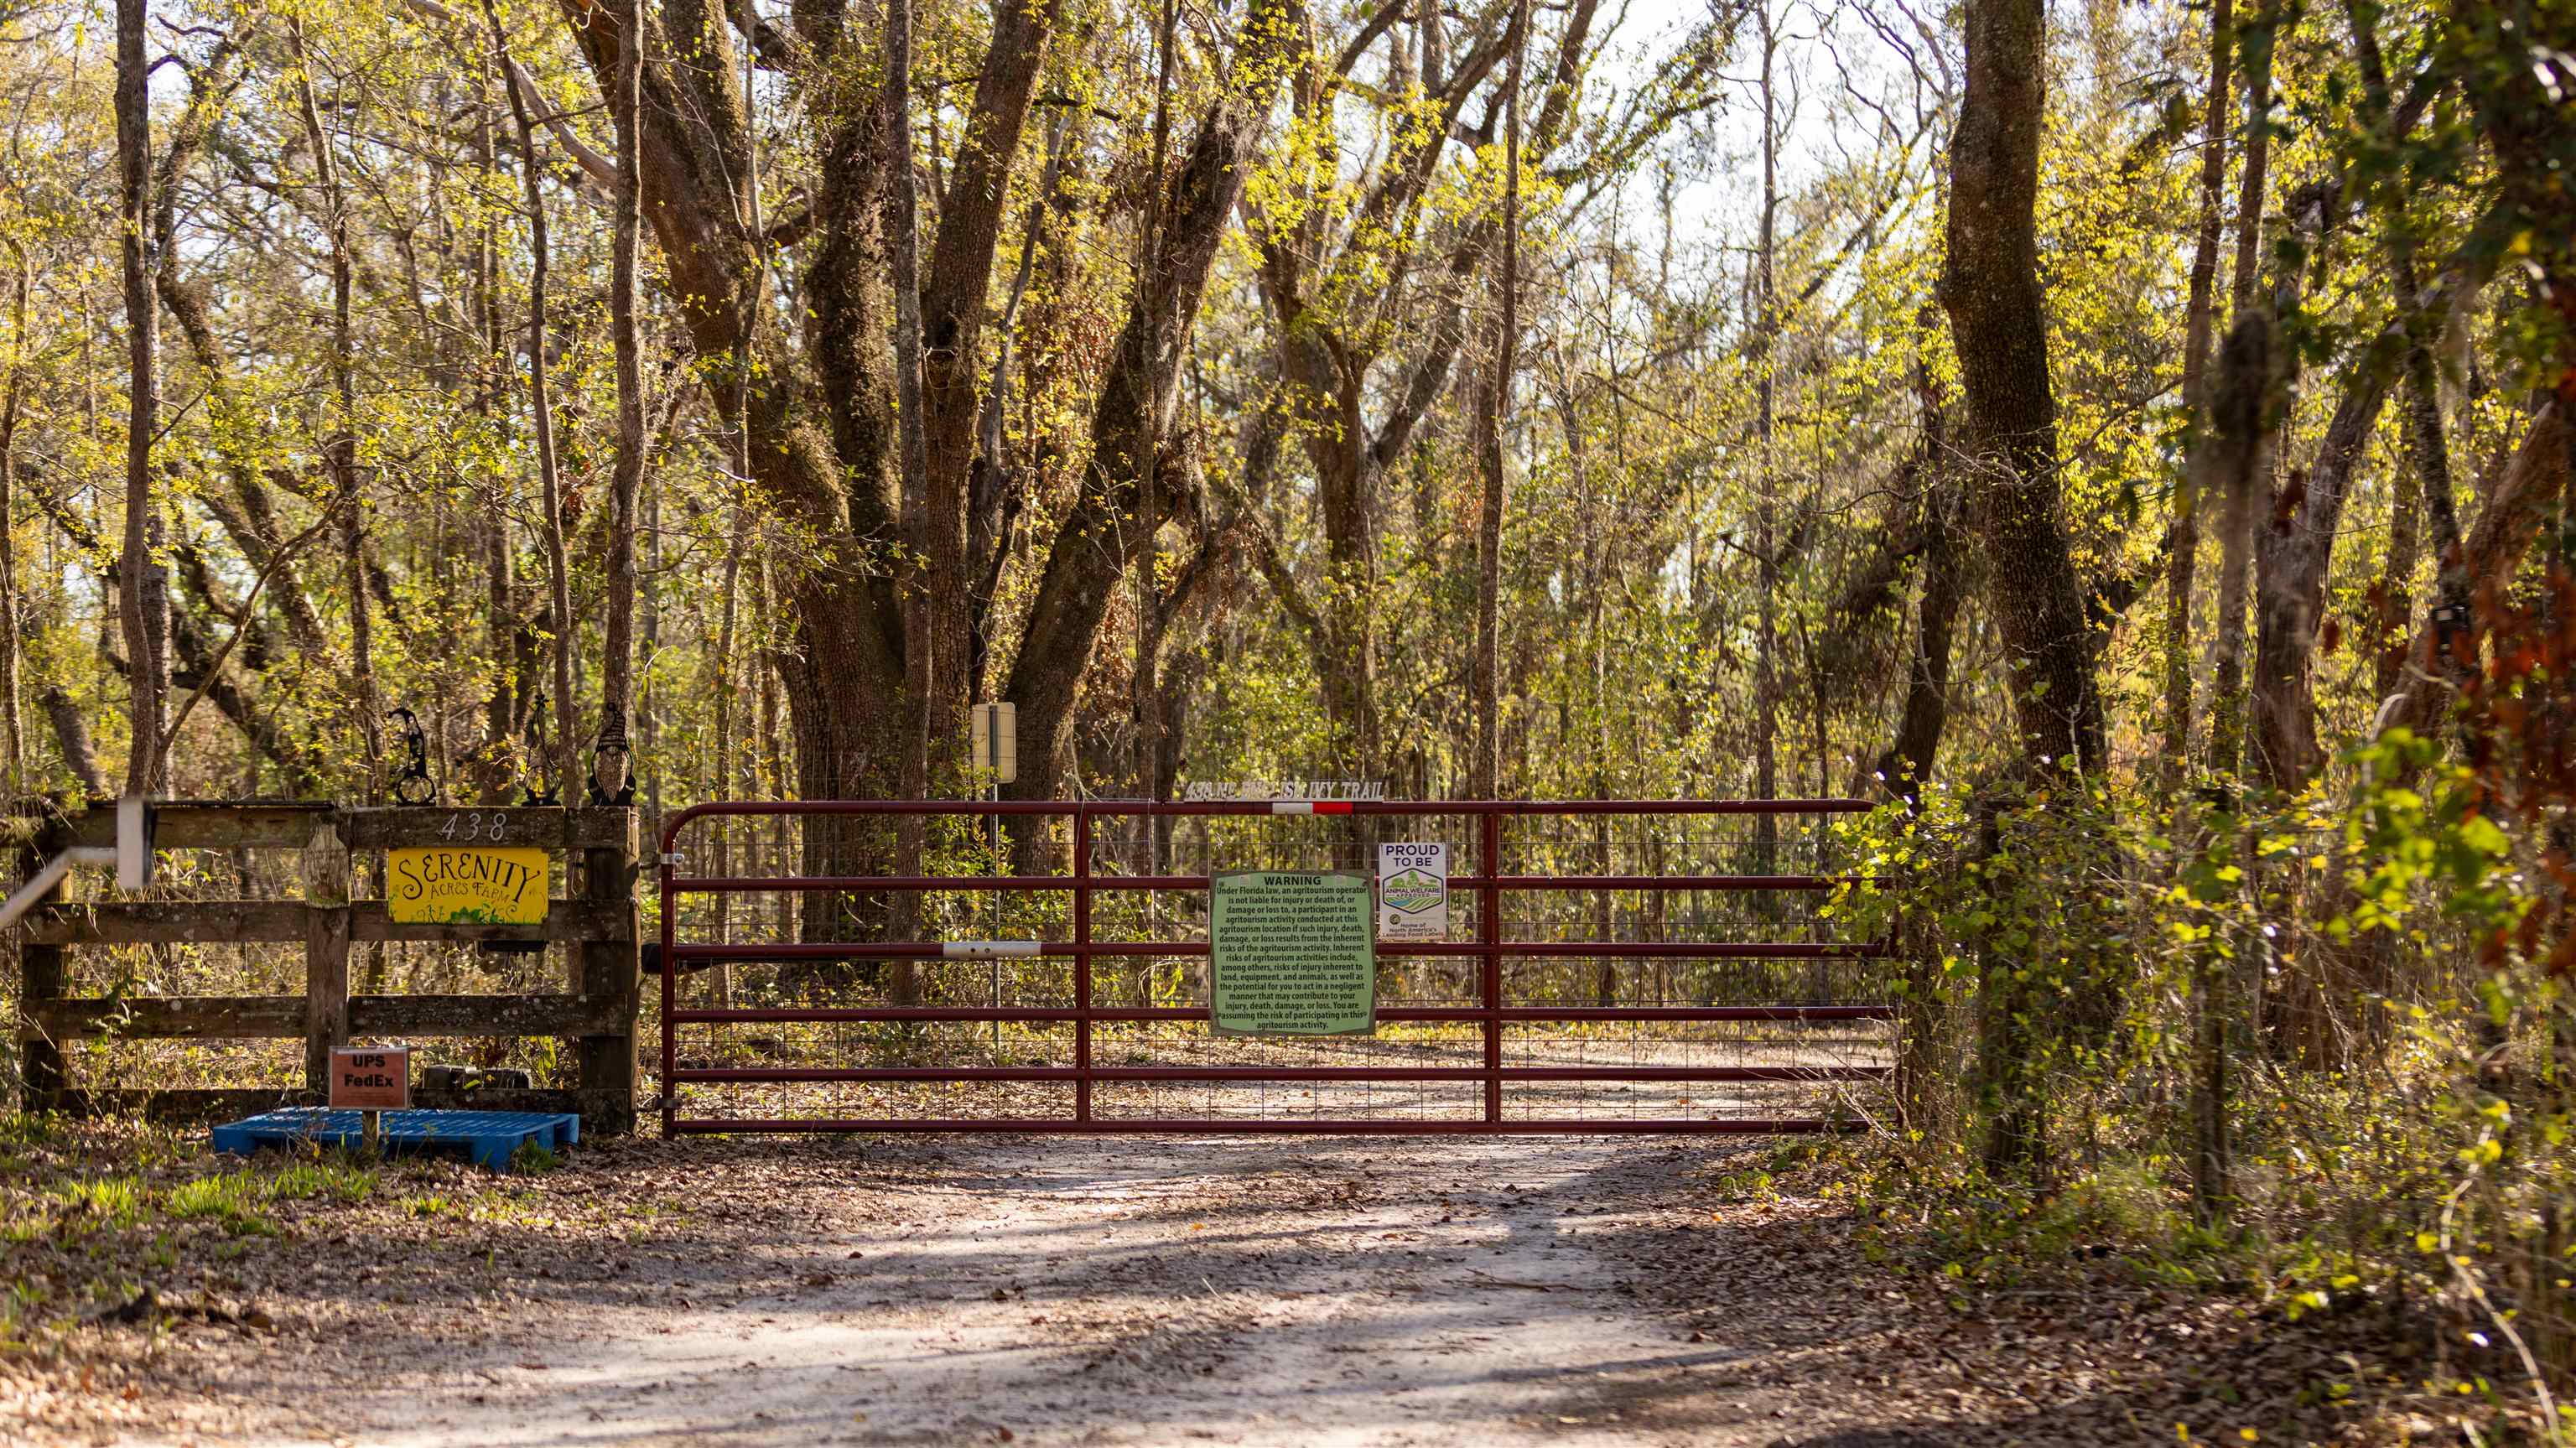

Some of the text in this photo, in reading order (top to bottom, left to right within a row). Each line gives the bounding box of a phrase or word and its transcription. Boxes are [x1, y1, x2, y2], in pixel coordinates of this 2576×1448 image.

[1309, 781, 1338, 798] IVY
[1342, 781, 1383, 799] TRAIL
[442, 812, 507, 841] 438
[1386, 845, 1439, 855] PROUD
[1394, 858, 1432, 866] TO BE
[398, 852, 541, 903] SERENITY
[1265, 876, 1322, 885] WARNING
[430, 883, 468, 899] ACRES
[1292, 887, 1334, 895] agritourism
[1336, 887, 1367, 895] operator
[1283, 896, 1303, 906] injury
[1227, 906, 1255, 915] damage
[1298, 906, 1337, 915] participant
[1226, 916, 1267, 924] agritourism
[1269, 916, 1296, 924] activity
[1219, 925, 1261, 934] agritourism
[1317, 925, 1339, 934] injury,
[1219, 935, 1250, 944] damage,
[1259, 944, 1301, 953] agritourism
[1303, 944, 1332, 953] activity.
[1253, 954, 1294, 963] agritourism
[1301, 963, 1322, 973] injury
[1240, 973, 1281, 982] equipment,
[1233, 983, 1266, 992] potential
[1330, 983, 1364, 992] negligent
[1225, 1002, 1248, 1010] injury,
[1275, 1002, 1306, 1010] damage,
[1221, 1011, 1255, 1020] assuming
[1293, 1011, 1339, 1020] participating
[1257, 1021, 1328, 1030] agritourism activity.
[352, 1054, 386, 1067] UPS
[345, 1073, 393, 1087] FedEx
